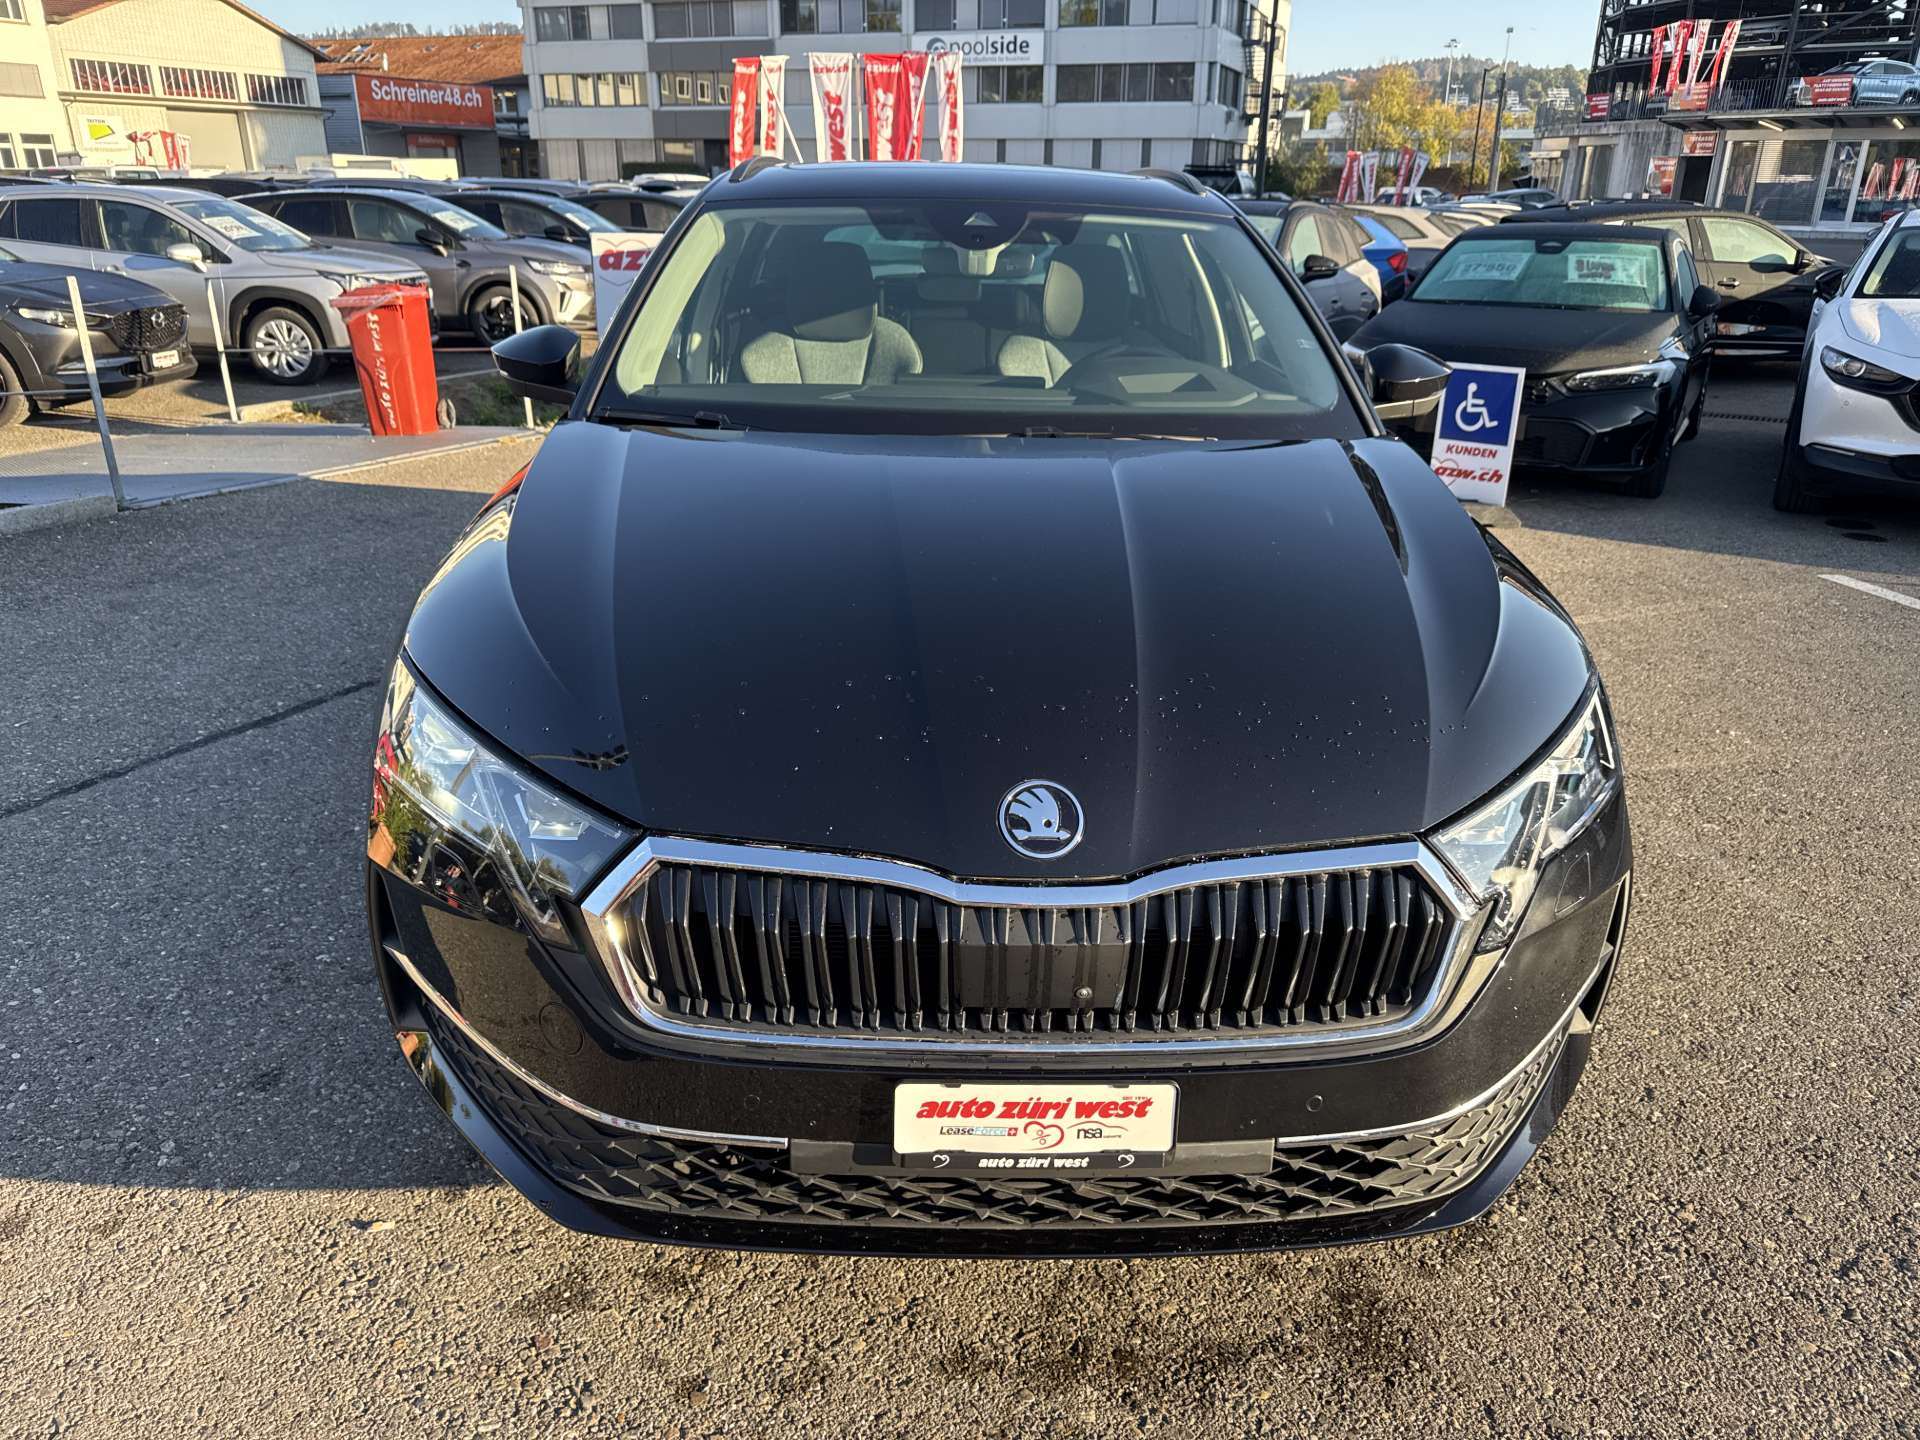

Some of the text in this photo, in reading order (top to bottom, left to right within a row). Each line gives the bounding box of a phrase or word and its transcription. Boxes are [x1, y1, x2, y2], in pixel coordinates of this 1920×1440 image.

[949, 35, 1030, 56] poolside
[371, 79, 483, 108] Schreiner48.ch
[823, 89, 846, 161] west
[1446, 443, 1498, 459] KUNDEN
[1434, 466, 1504, 483] azw.ch
[916, 1096, 1154, 1120] auto züri west
[940, 1126, 1008, 1136] LeaseForce
[1076, 1128, 1103, 1139] nsa
[978, 1156, 1090, 1168] auto züri west
